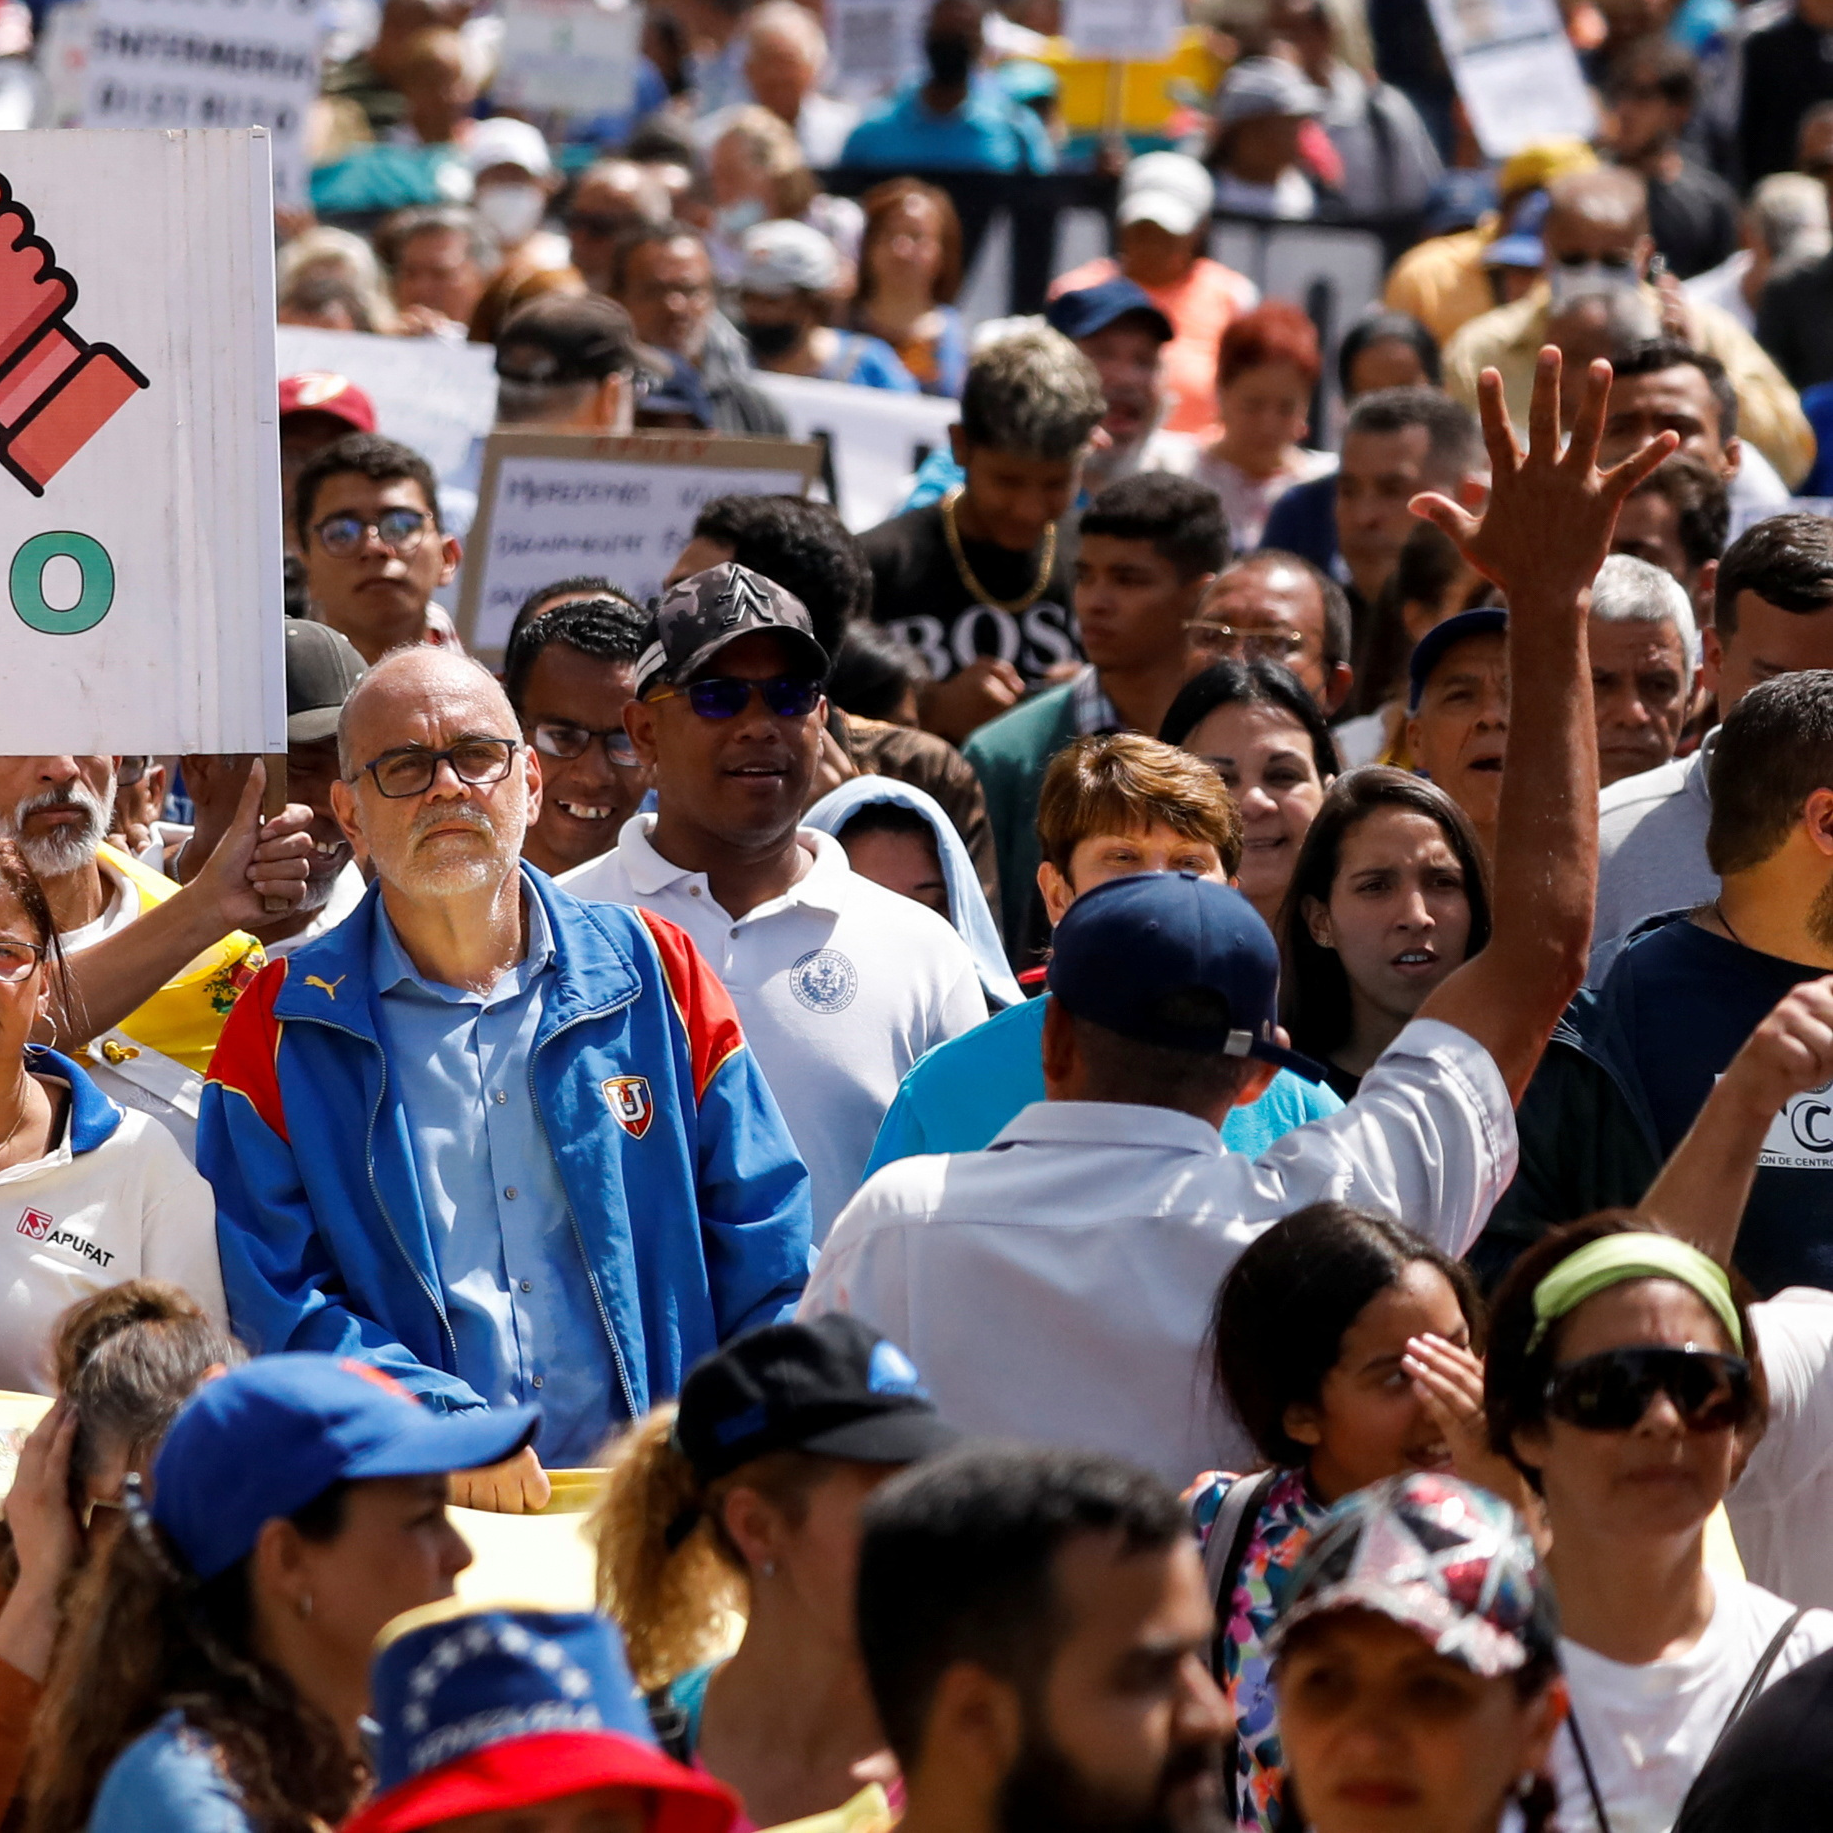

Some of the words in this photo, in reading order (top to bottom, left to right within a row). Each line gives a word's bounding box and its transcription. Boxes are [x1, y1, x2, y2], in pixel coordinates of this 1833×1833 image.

[887, 601, 1082, 680] BOS
[1778, 1157, 1793, 1166] DE
[45, 1226, 115, 1270] APUFAT
